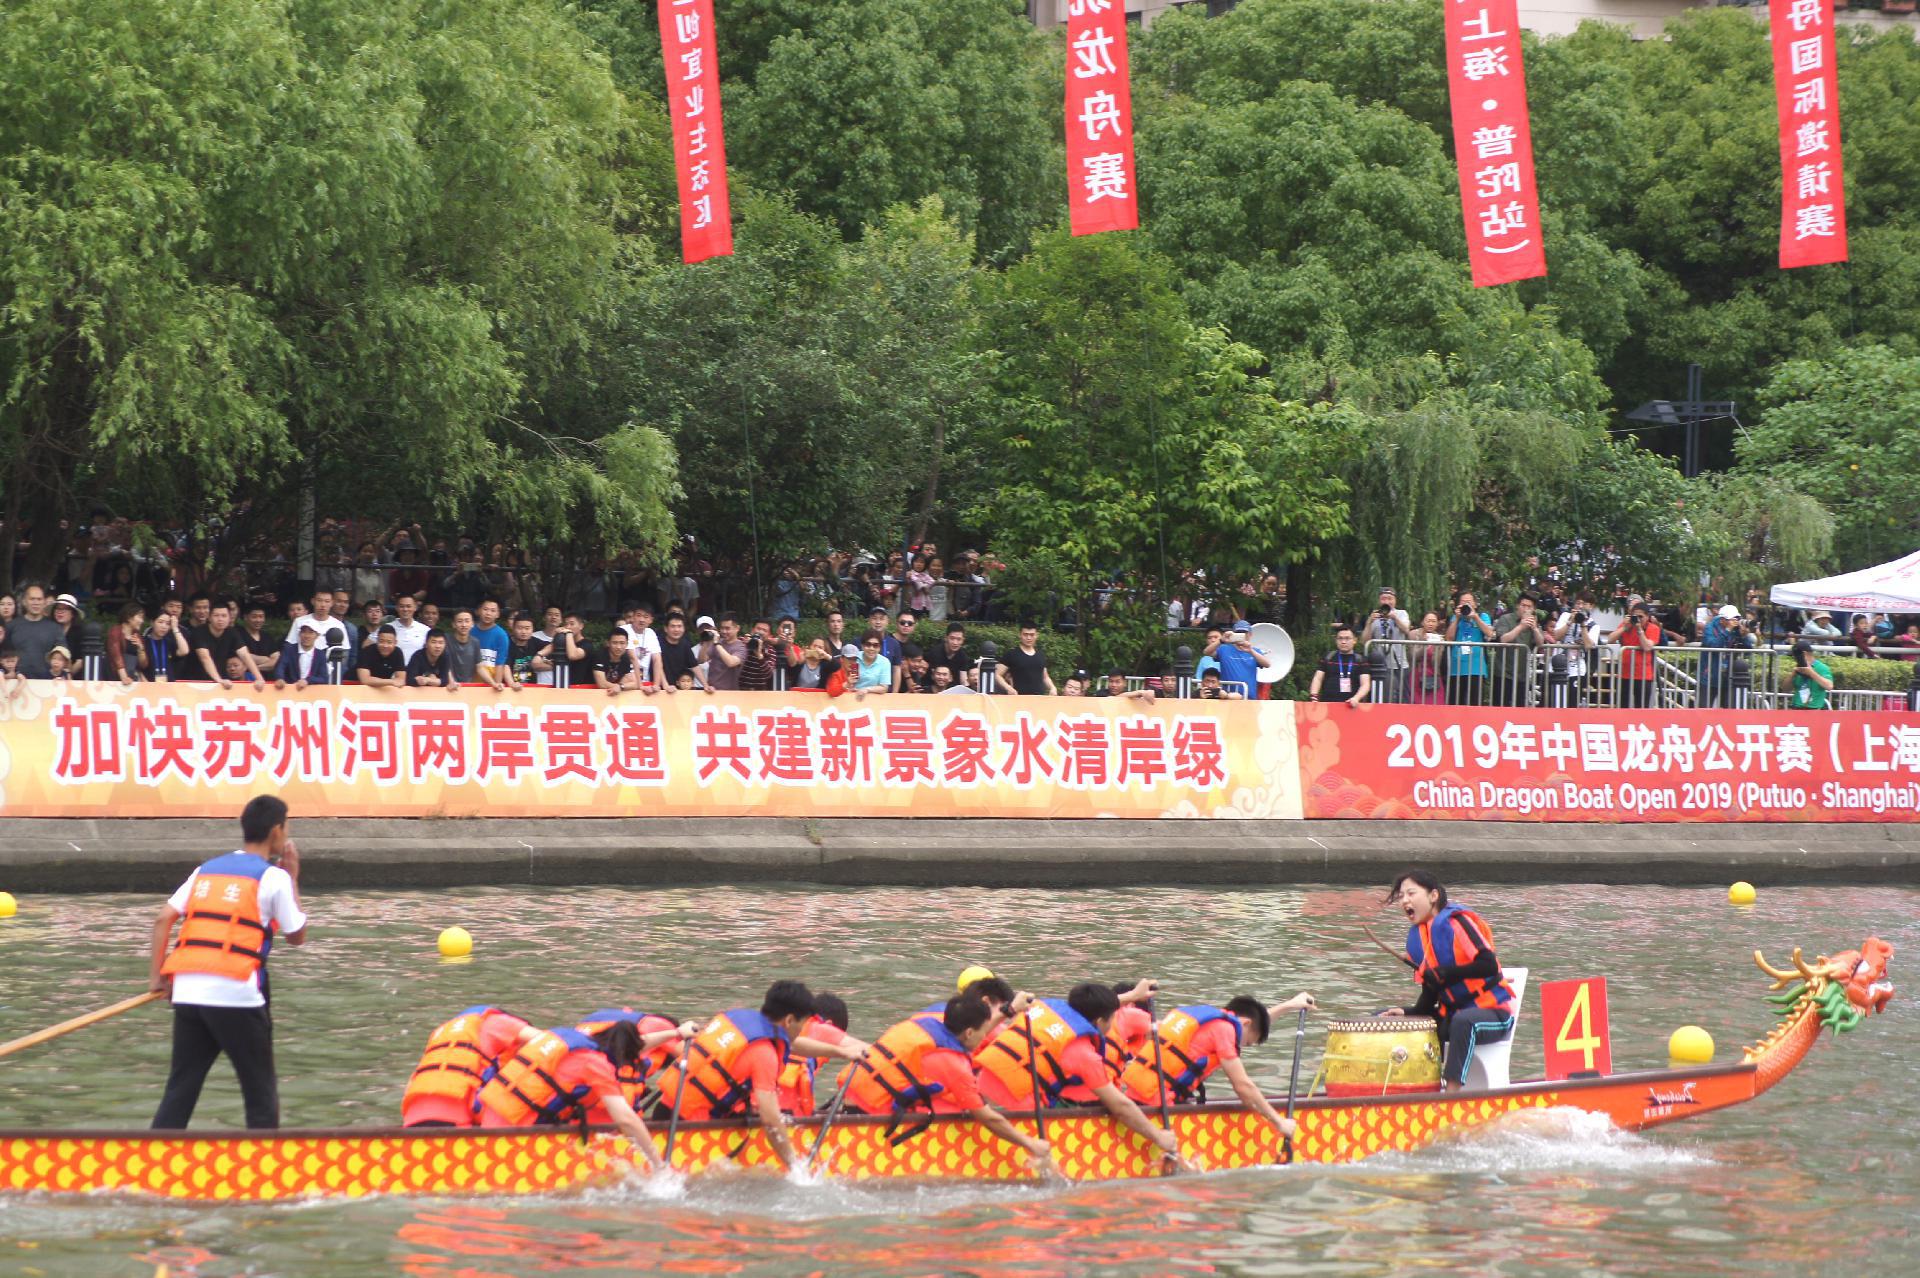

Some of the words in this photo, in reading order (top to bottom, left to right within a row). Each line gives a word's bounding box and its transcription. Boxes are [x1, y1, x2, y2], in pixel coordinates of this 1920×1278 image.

[54, 703, 667, 782] 加快苏州河两岸贯通
[695, 711, 1226, 787] 共建新景象水清岸绿
[1413, 779, 1475, 808] China
[1479, 781, 1559, 814] Dragon
[1563, 782, 1614, 809] Boat
[1619, 782, 1677, 815] Open
[1682, 783, 1732, 809] 2019
[1555, 982, 1602, 1070] 4
